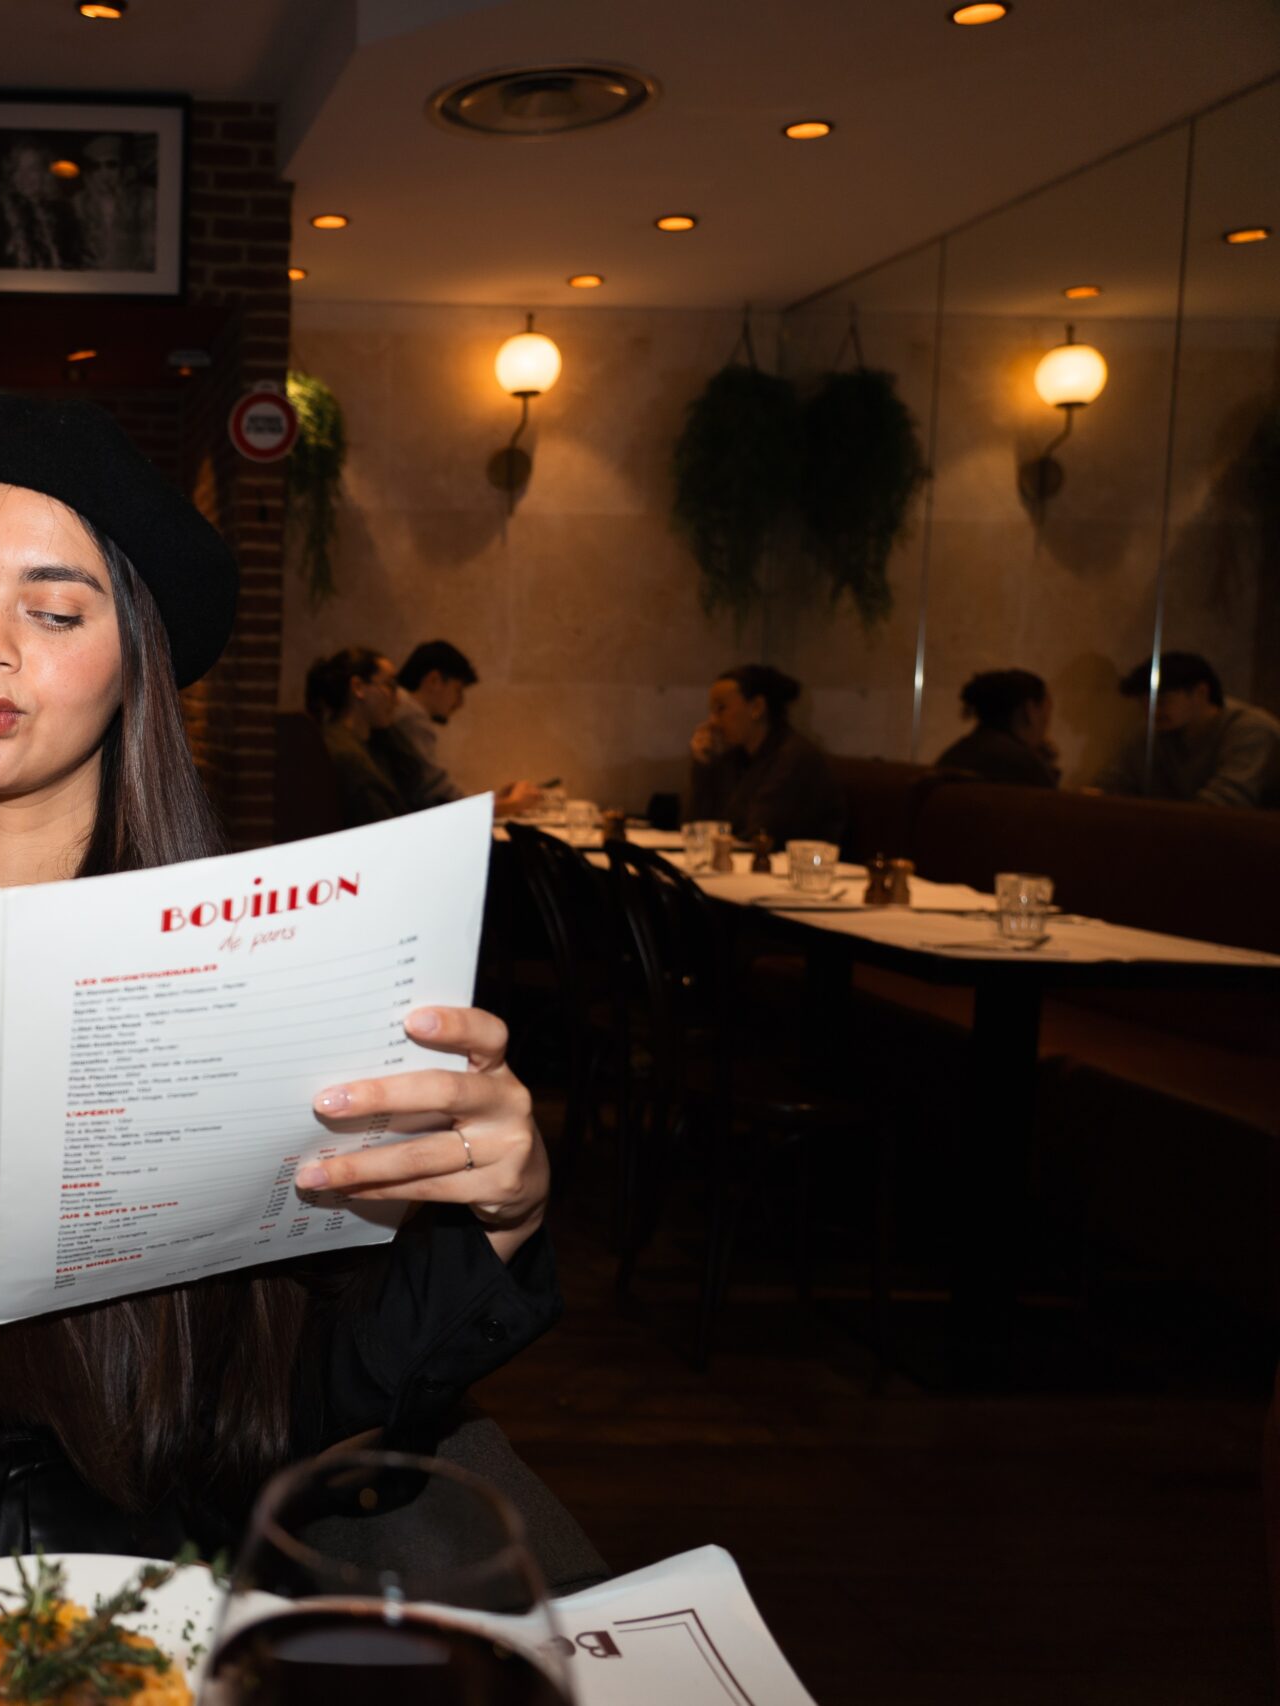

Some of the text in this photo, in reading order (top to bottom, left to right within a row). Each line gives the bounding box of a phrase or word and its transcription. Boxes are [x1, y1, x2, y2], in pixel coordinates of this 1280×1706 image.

[161, 873, 361, 932] BOUILLON
[250, 926, 297, 954] paris
[74, 977, 97, 987] LES
[94, 1207, 127, 1216] SOFTS
[55, 1264, 82, 1274] EAUX
